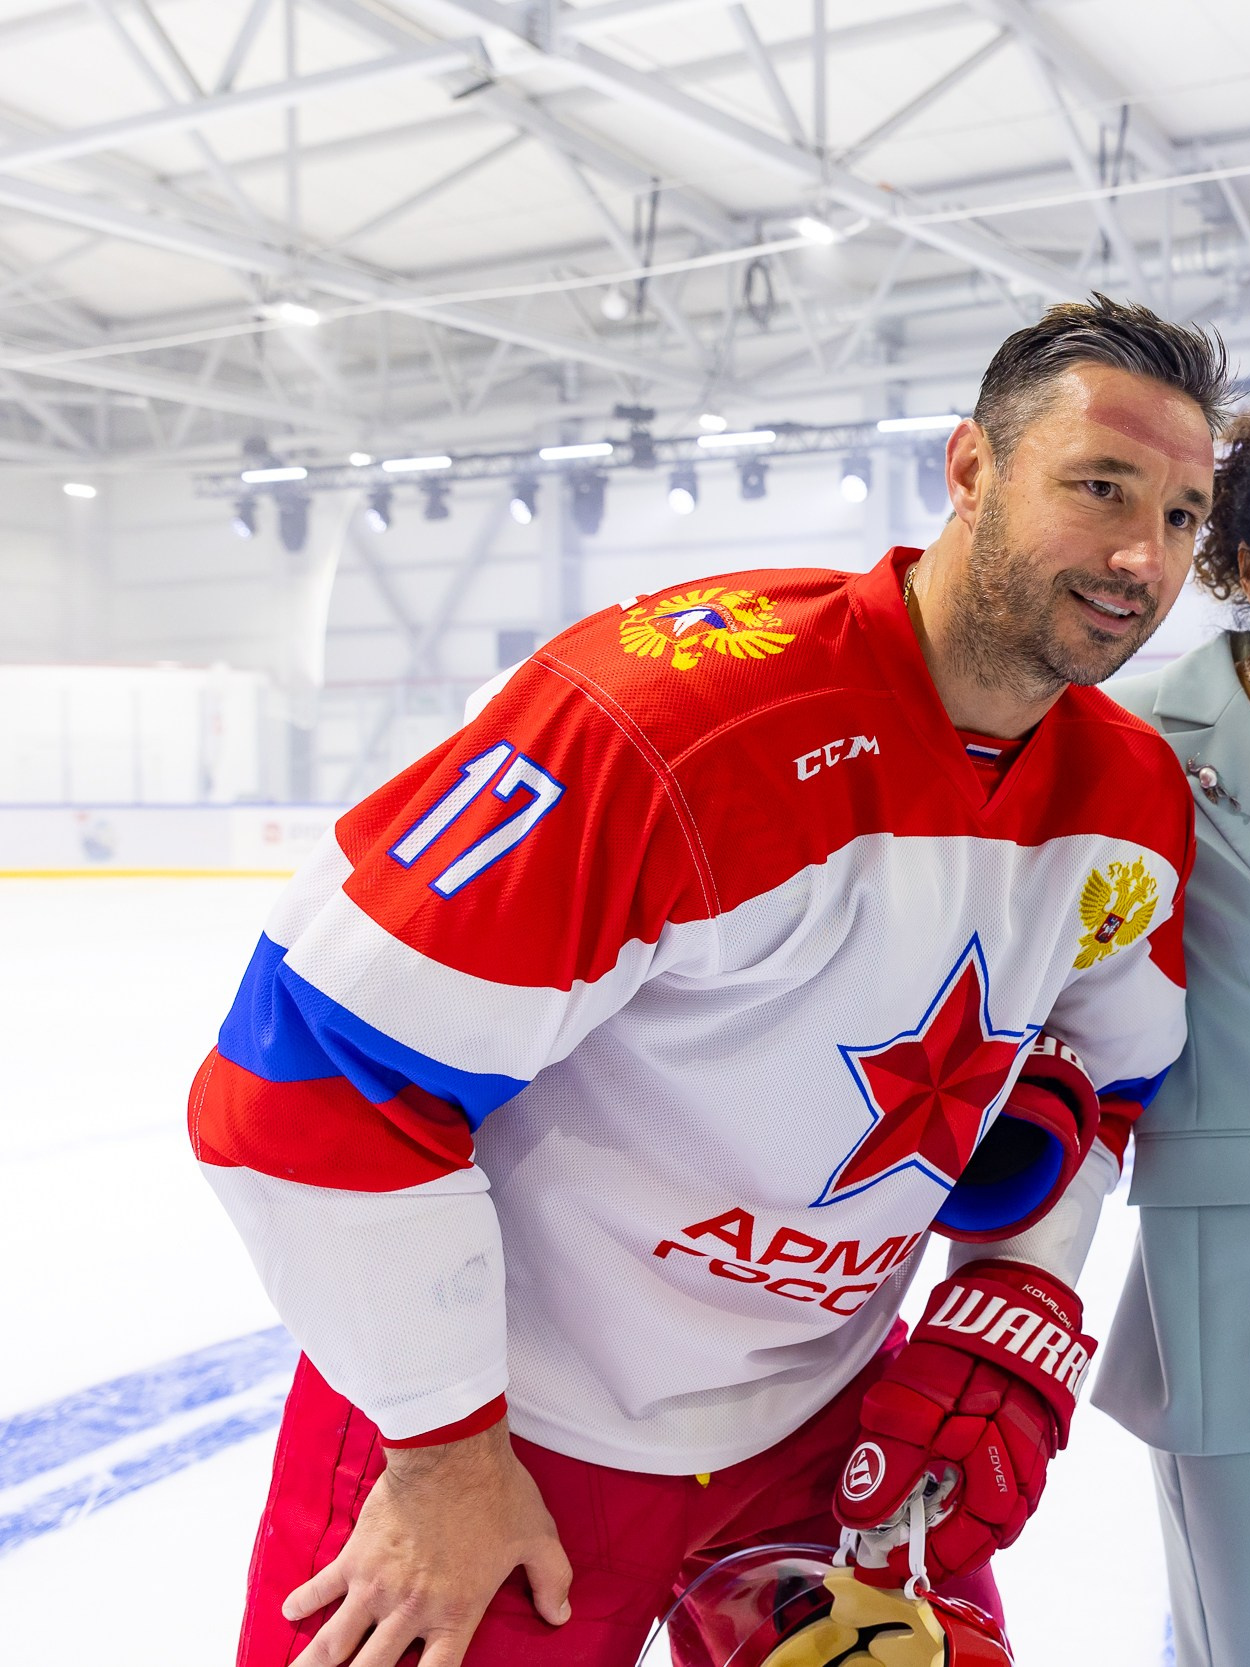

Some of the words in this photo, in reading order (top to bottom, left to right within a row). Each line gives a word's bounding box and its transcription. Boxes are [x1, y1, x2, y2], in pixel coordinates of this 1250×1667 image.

[792, 735, 880, 781] CCM
[386, 739, 567, 900] 17
[988, 1446, 1008, 1493] COVER
